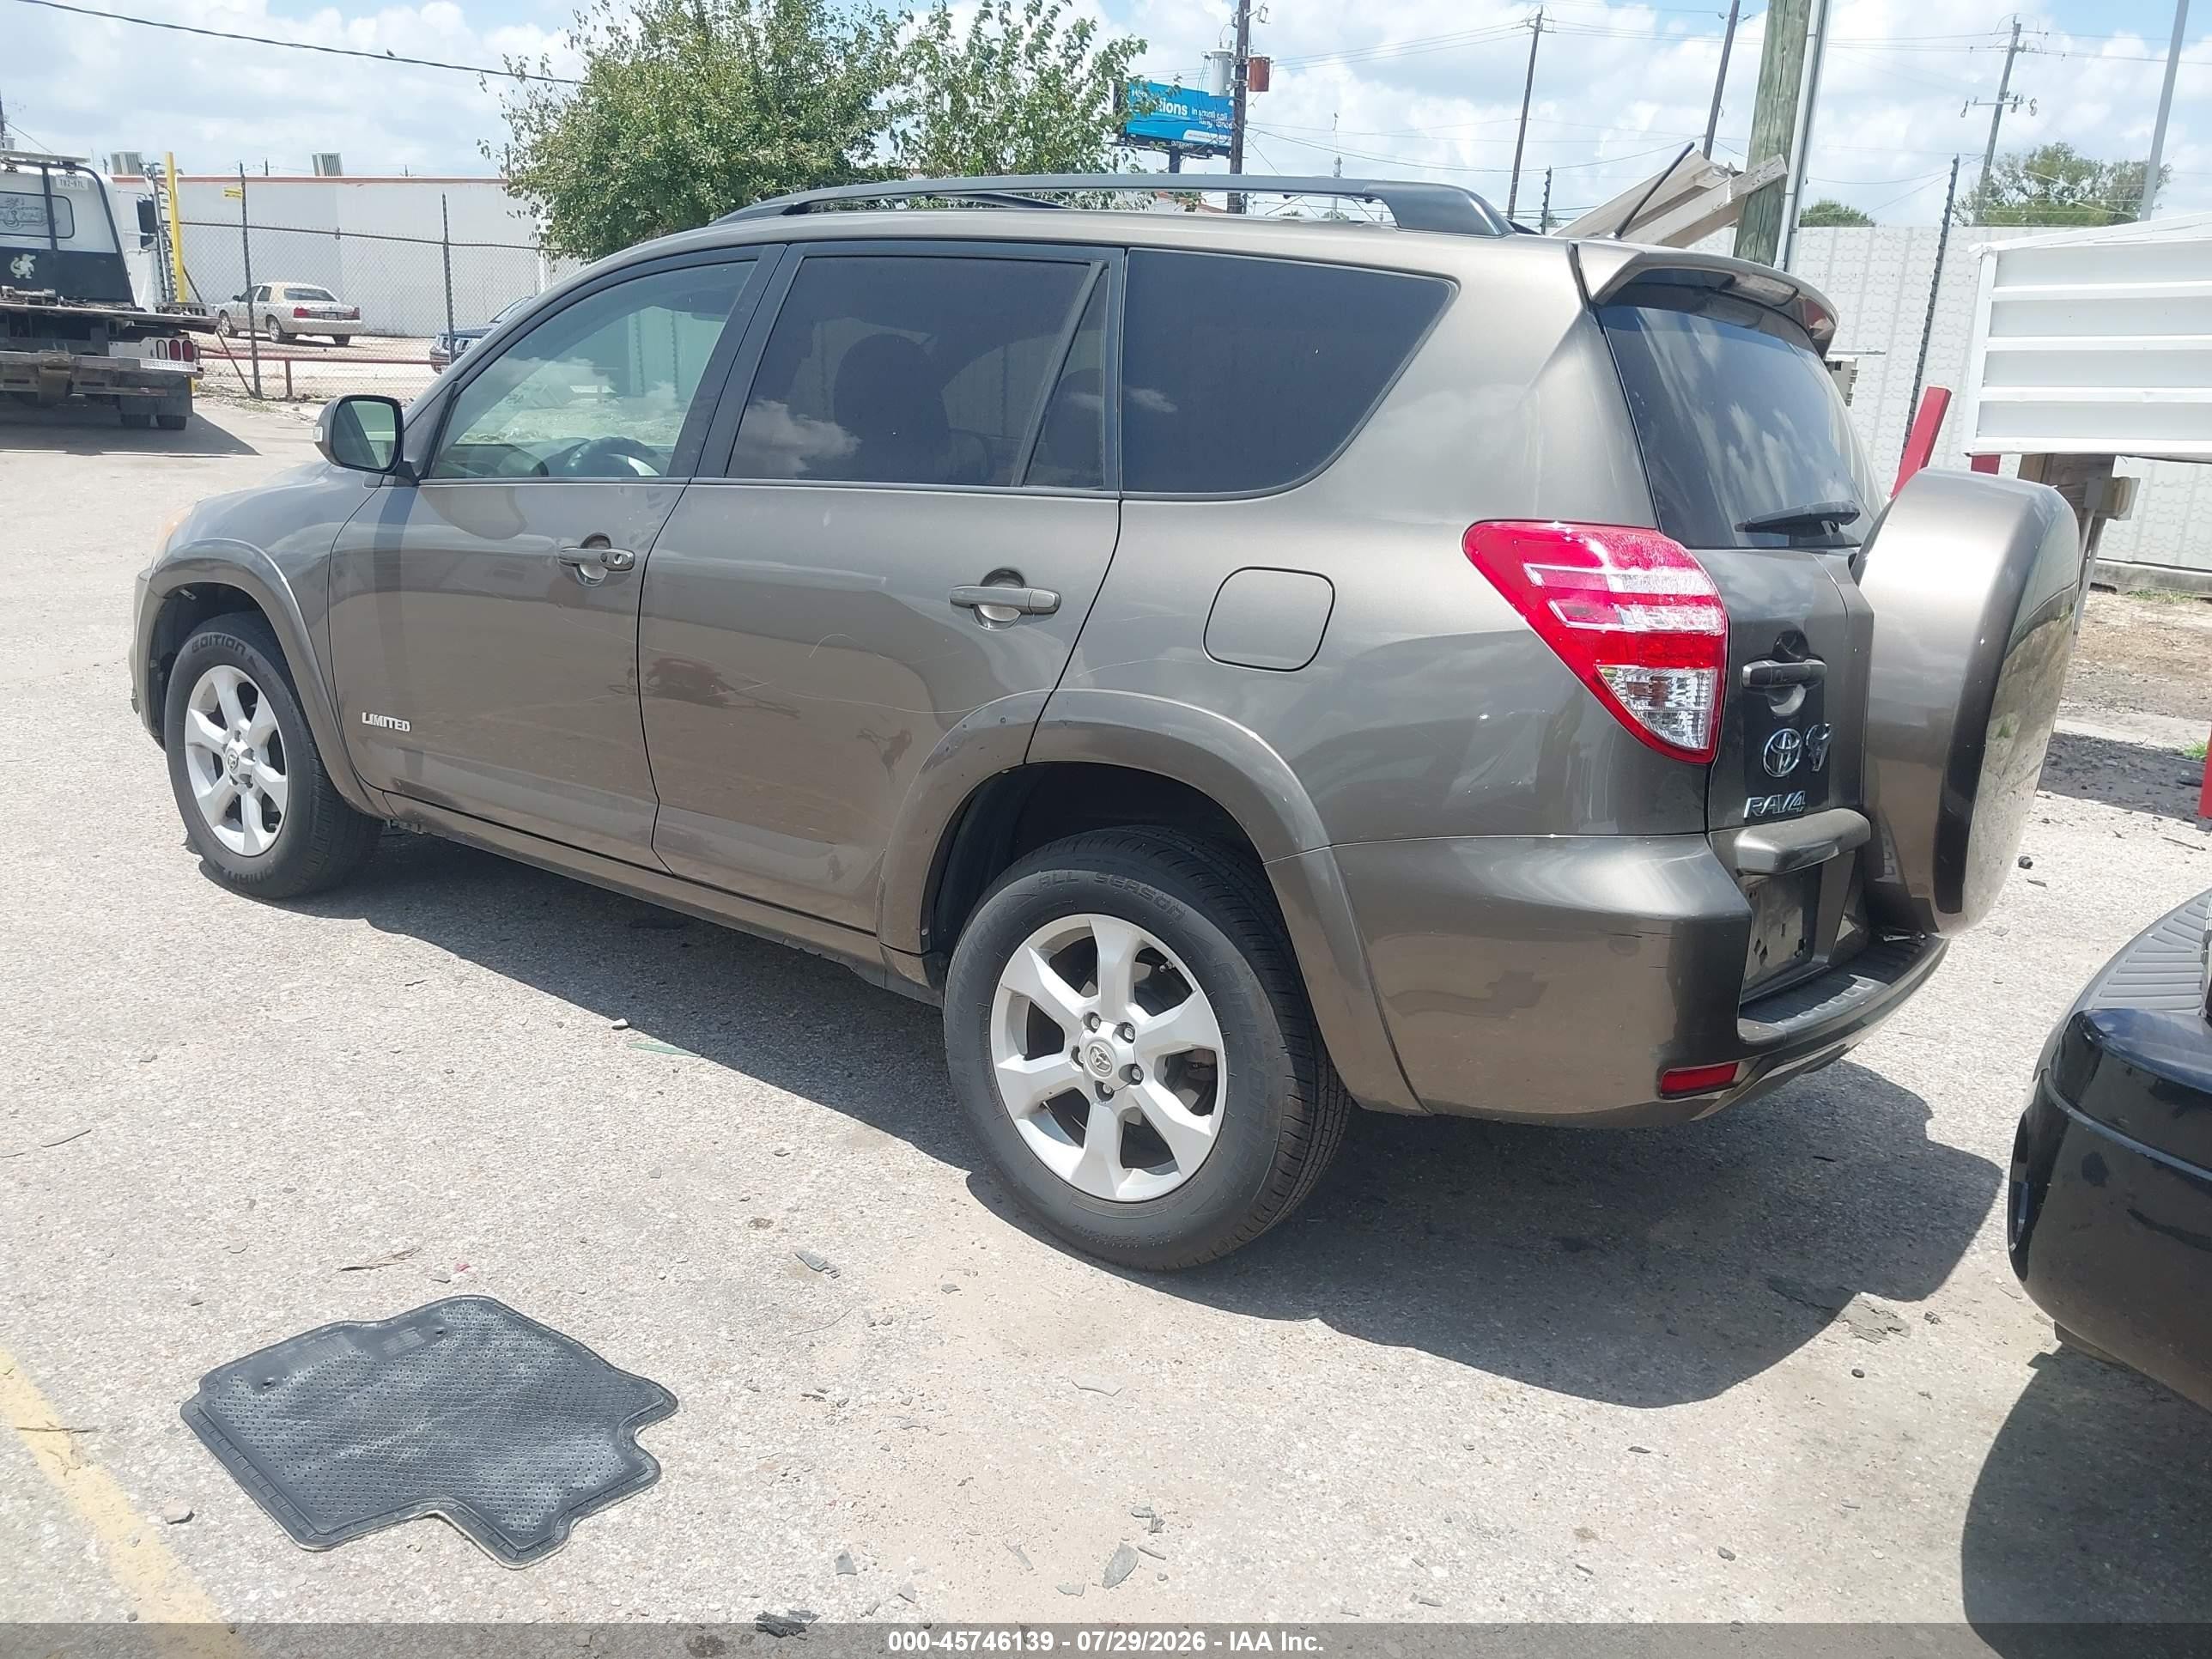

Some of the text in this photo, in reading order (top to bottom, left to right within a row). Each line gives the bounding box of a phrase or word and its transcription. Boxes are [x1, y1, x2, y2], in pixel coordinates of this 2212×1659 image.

[191, 634, 246, 657] EDITION
[362, 711, 411, 732] LIMITED
[1743, 790, 1806, 818] RAV4
[1037, 870, 1188, 922] ALL SEASON
